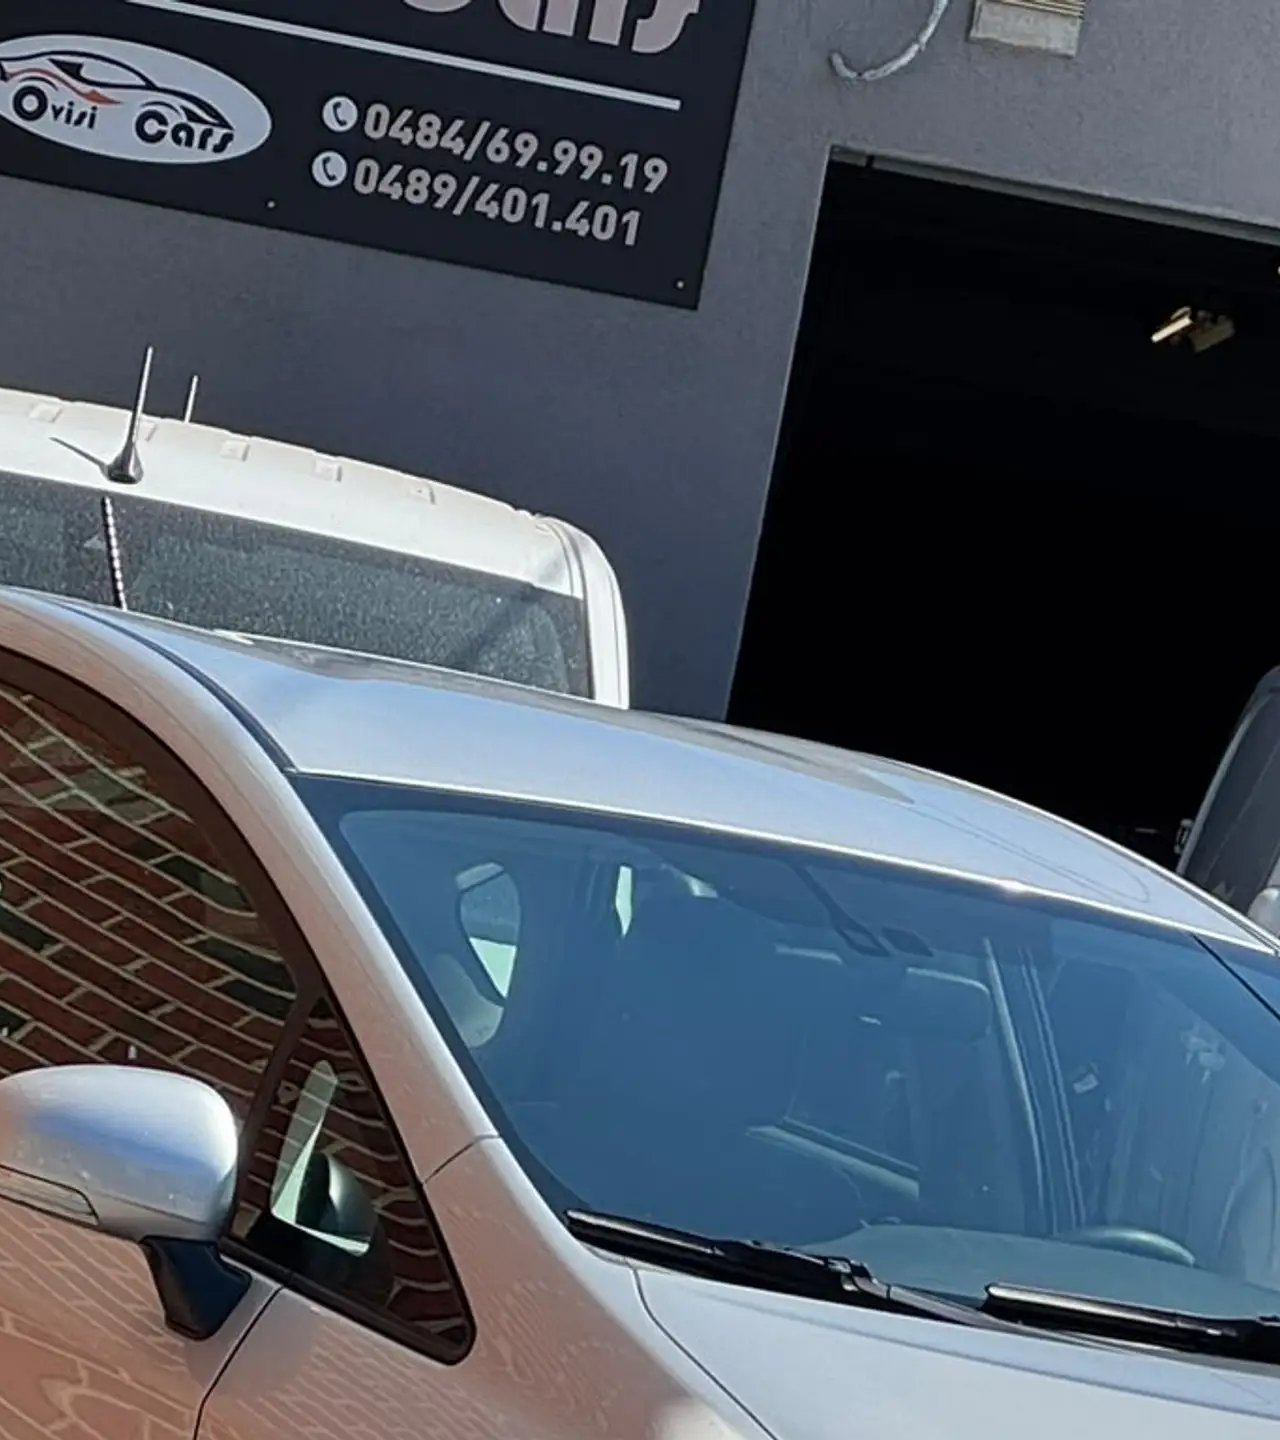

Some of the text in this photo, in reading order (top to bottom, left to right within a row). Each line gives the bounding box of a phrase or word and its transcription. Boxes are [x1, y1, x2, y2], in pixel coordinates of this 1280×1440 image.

[12, 86, 235, 154] Ovisi Cars
[364, 103, 668, 194] 0484/69.99.19
[353, 158, 640, 246] 0489/401.401
